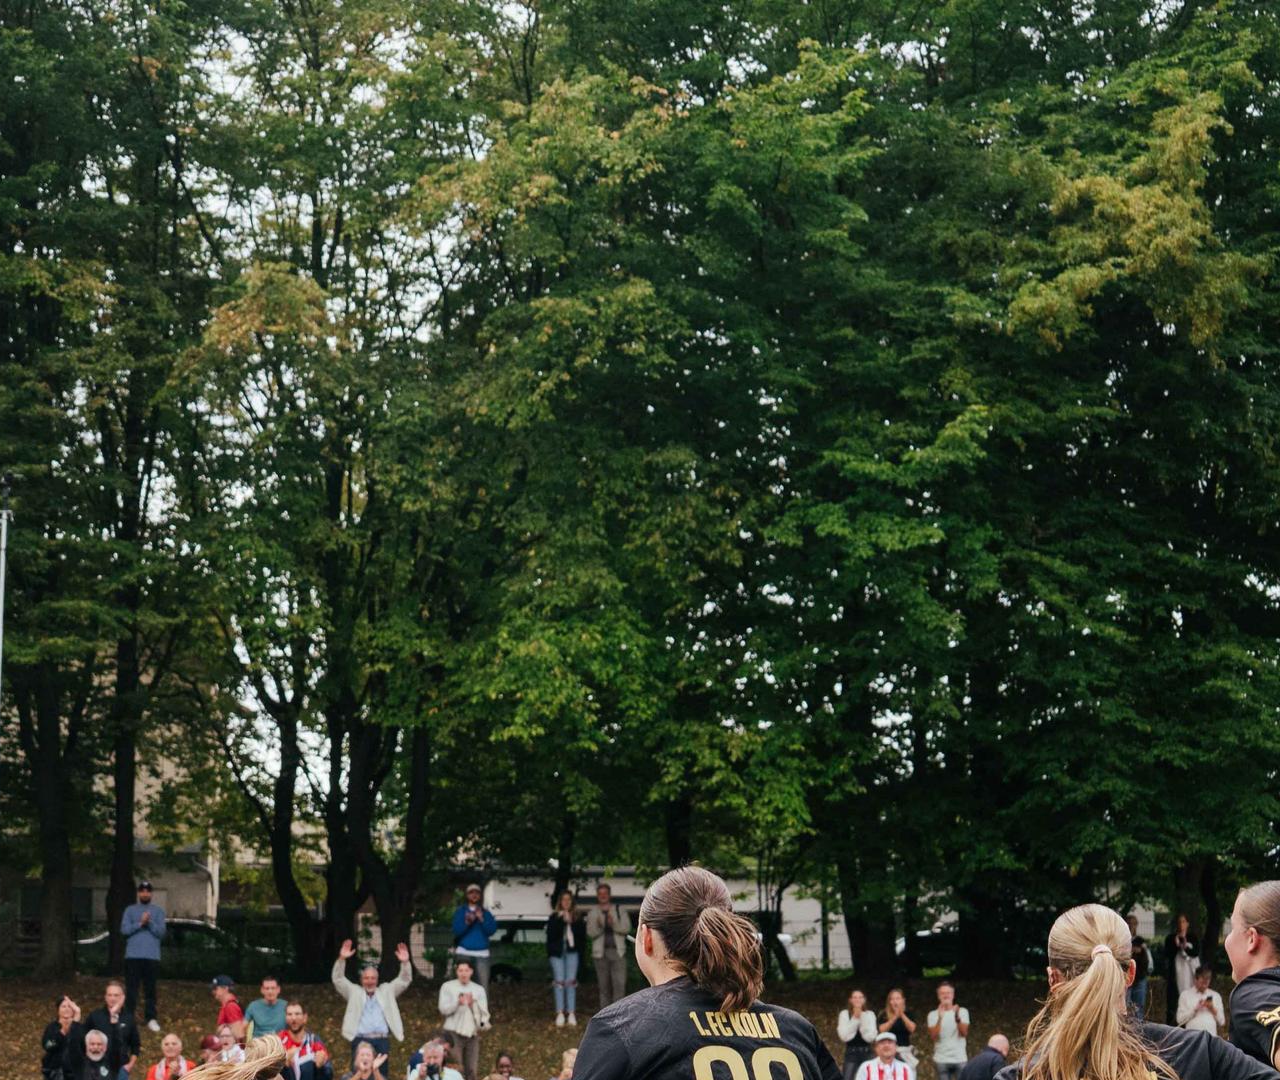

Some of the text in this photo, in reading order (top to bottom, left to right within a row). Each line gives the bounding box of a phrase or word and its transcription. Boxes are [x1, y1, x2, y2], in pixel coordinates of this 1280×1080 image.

[689, 1008, 781, 1039] 1. FC KÖLN
